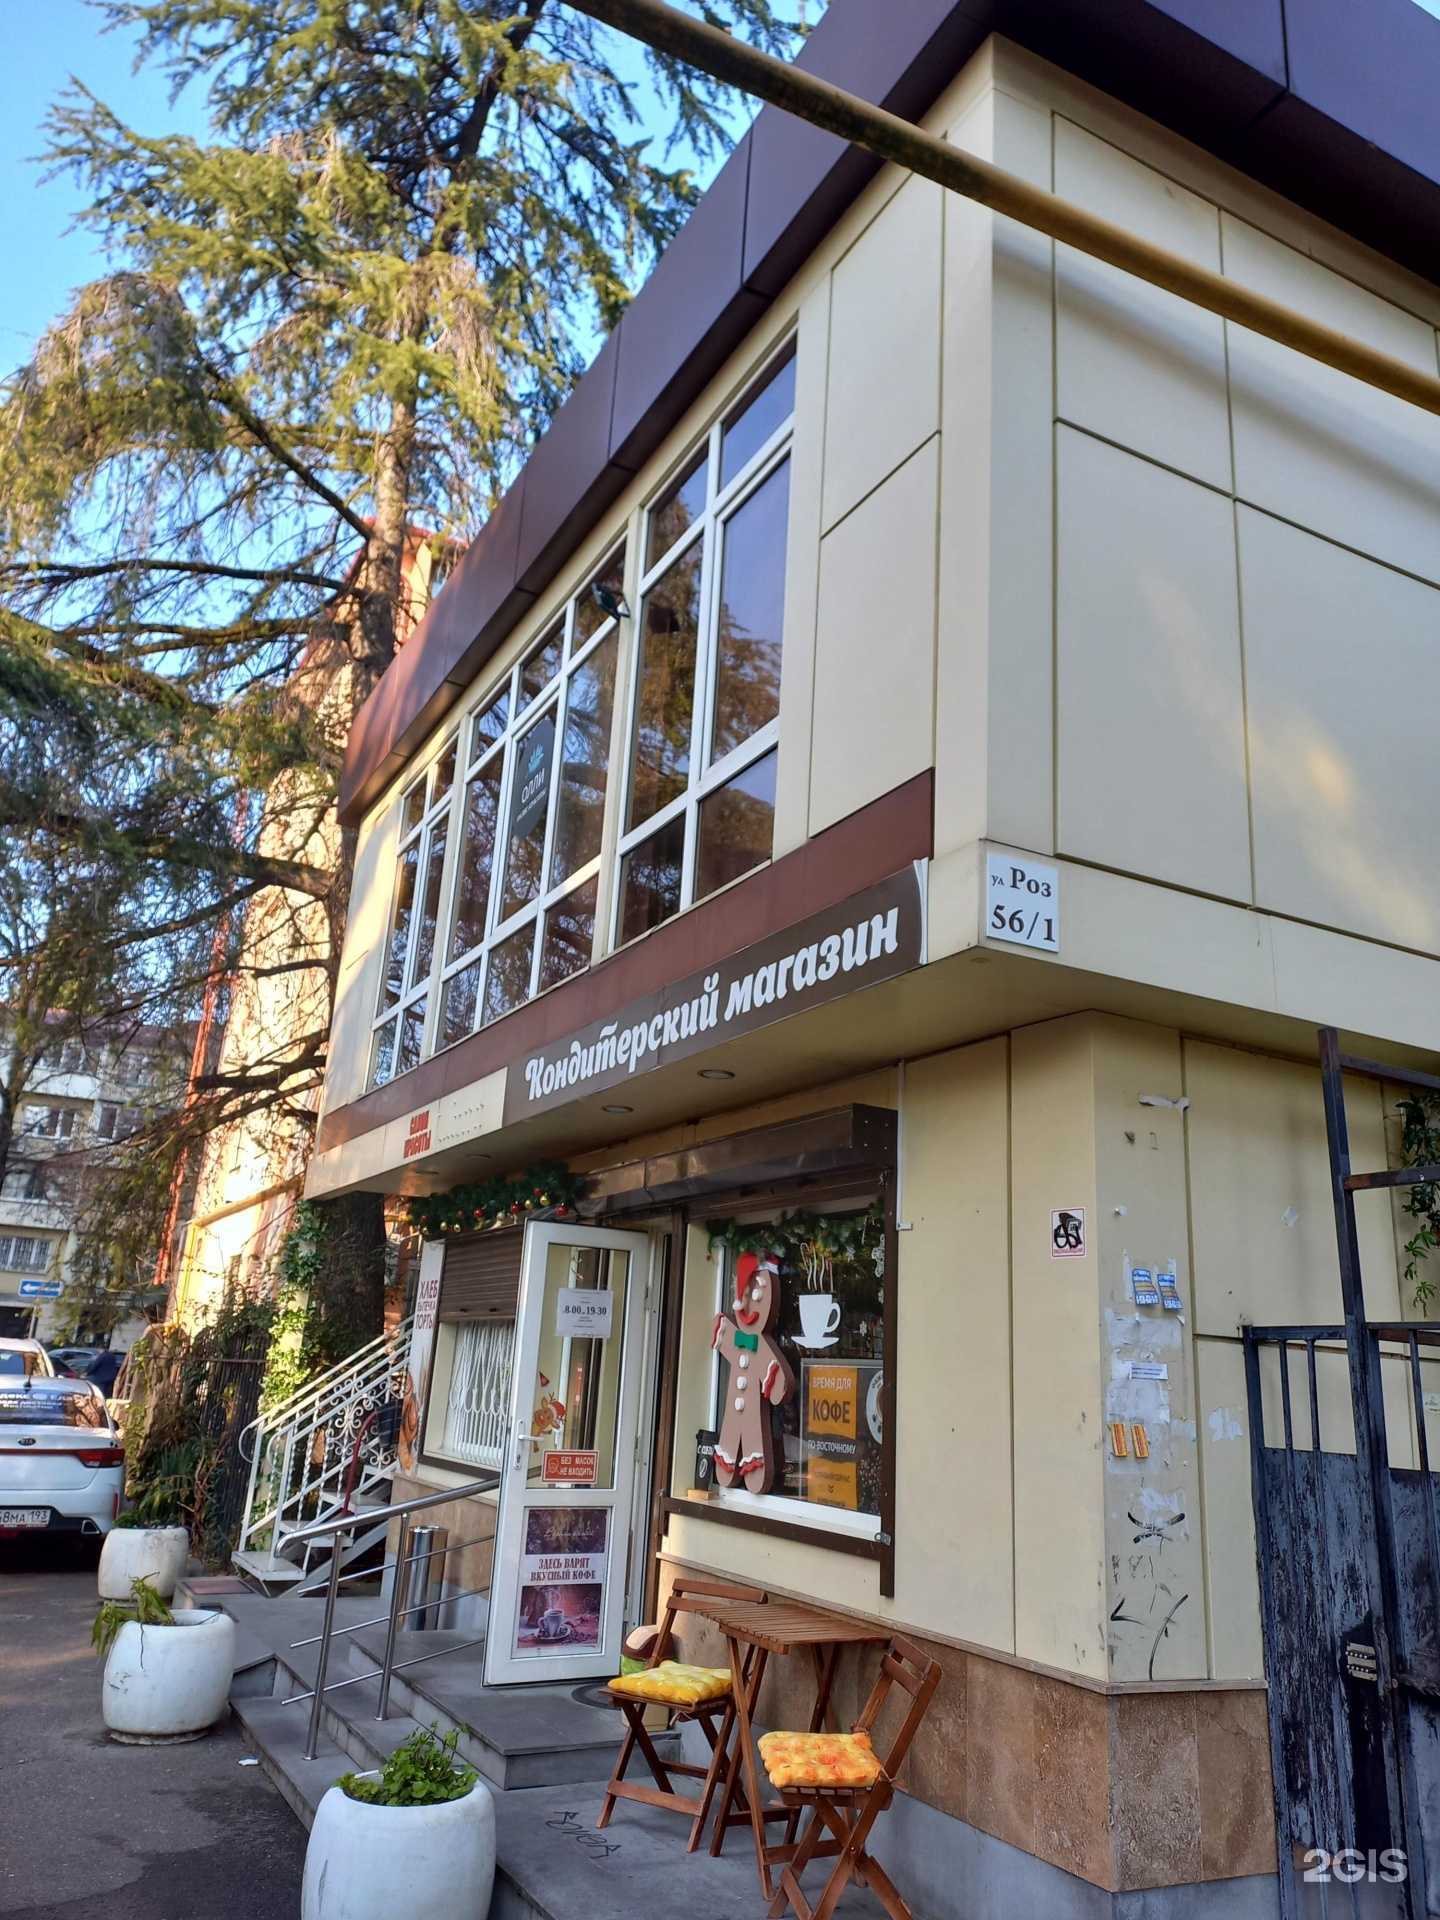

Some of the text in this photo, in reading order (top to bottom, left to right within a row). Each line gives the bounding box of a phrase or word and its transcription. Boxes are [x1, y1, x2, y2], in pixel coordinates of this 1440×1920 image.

[991, 866, 1052, 898] ул Роз
[991, 904, 1056, 943] 56/1
[524, 906, 900, 1101] Кондитерский магазин
[419, 1279, 438, 1299] ХЛЕБ
[812, 1376, 835, 1390] ВРЕМЯ
[835, 1377, 853, 1392] ДЛЯ
[812, 1398, 851, 1425] КОФЕ
[560, 1455, 572, 1465] БЕЗ
[538, 1557, 590, 1570] ЗДЕСЬ ВАРЯТ
[530, 1569, 596, 1582] ВКУСНЫЙ КОФЕ
